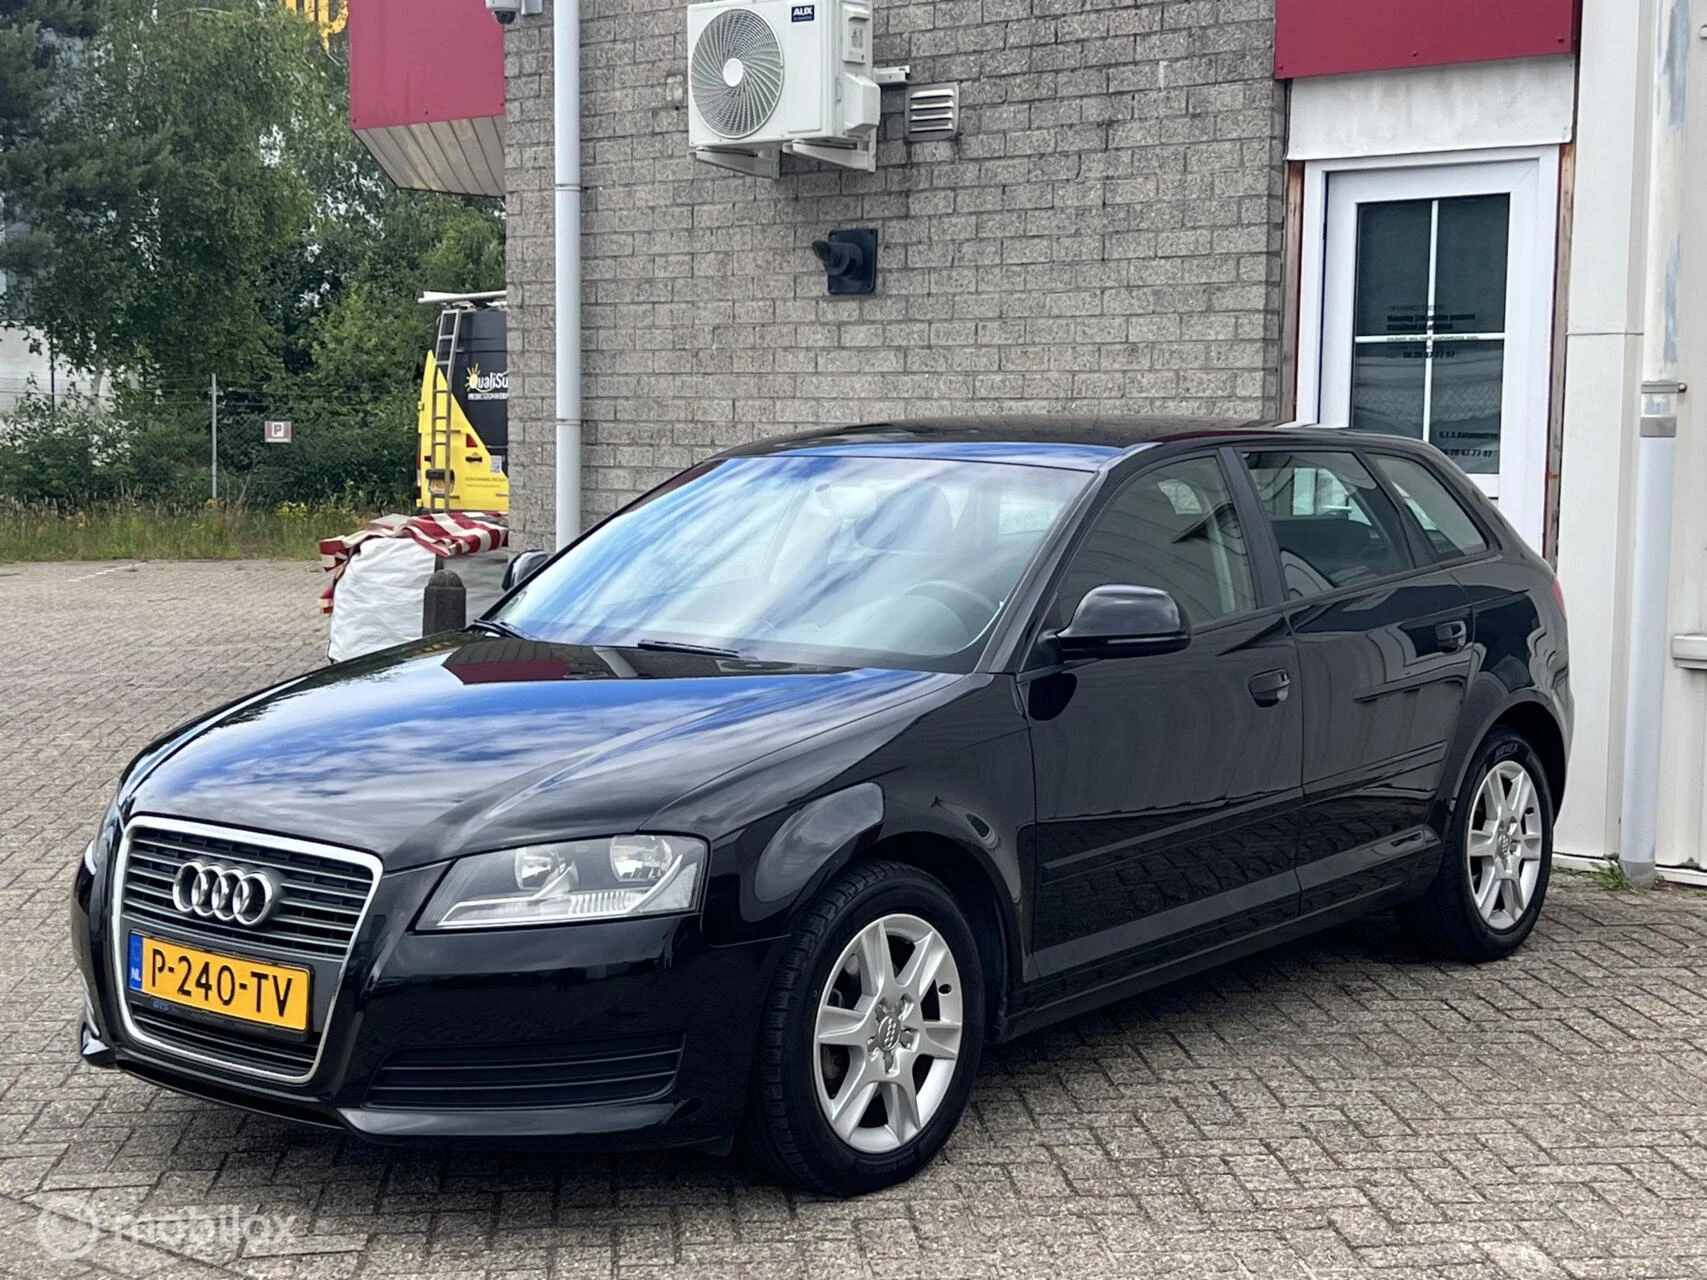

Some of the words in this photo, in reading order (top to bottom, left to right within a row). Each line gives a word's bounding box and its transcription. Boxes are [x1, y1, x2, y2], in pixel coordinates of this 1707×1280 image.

[793, 7, 813, 16] AUX
[274, 424, 282, 435] P
[130, 966, 142, 982] NL
[152, 948, 293, 1018] P-240-TV
